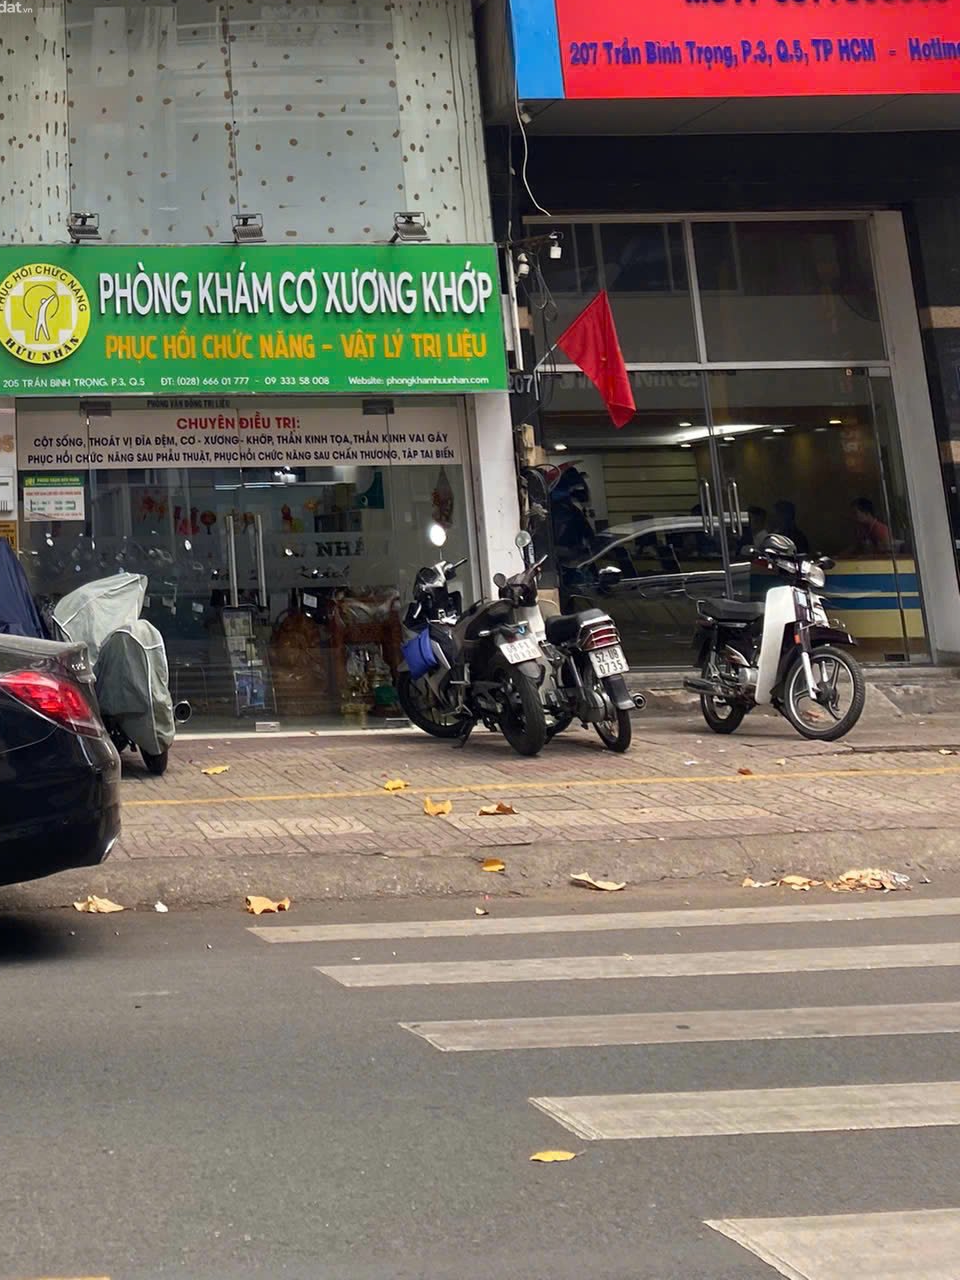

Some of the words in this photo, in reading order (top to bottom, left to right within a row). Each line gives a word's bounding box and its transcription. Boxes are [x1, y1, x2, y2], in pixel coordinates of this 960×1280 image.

[570, 41, 598, 65] 207
[602, 37, 642, 65] Trần
[644, 40, 682, 64] Bình
[685, 40, 739, 69] Trọng,
[740, 39, 773, 67] P.3,
[776, 39, 809, 65] Q.5,
[810, 38, 833, 62] TP
[837, 38, 876, 62] HCM
[99, 262, 192, 315] PHÒNG
[198, 262, 274, 314] KHÁM
[279, 268, 318, 314] CƠ
[322, 268, 418, 314] XƯƠNG
[422, 261, 493, 314] KHỚP
[105, 334, 157, 364] PHỤC
[163, 326, 197, 360] HỒI
[202, 328, 254, 360] CHỨC
[259, 330, 316, 359] NĂNG
[341, 328, 377, 362] VẬT
[383, 327, 404, 358] LÝ
[411, 333, 442, 362] TRỊ
[447, 327, 487, 362] LIỆU
[3, 379, 19, 388] 205
[176, 376, 200, 386] (028)
[202, 377, 219, 386] 666
[221, 377, 231, 386] 01
[233, 377, 249, 385] 777
[264, 377, 276, 385] 09
[280, 377, 296, 385] 333
[299, 377, 310, 385] 58
[312, 376, 330, 385] 008
[348, 376, 384, 385] Website:
[176, 414, 236, 430] CHUYÊN
[240, 410, 272, 430] ĐIỀU
[275, 417, 301, 432] TRỊ:
[33, 435, 53, 450] CỘT
[56, 434, 86, 449] SỐNG,
[89, 435, 120, 447] THOÁT
[123, 436, 133, 449] VỊ
[154, 434, 178, 448] ĐỆM,
[180, 435, 196, 446] CƠ
[204, 435, 239, 445] XƯƠNG
[246, 433, 275, 446] KHỚP,
[276, 430, 302, 445] THẦN
[305, 433, 328, 444] KINH
[382, 433, 406, 443] KINH
[408, 433, 425, 443] VAI
[28, 454, 53, 466] PHỤC
[56, 450, 73, 464] HỒI
[75, 451, 103, 464] CHỨC
[137, 453, 153, 463] SAU
[214, 452, 239, 463] PHỤC
[258, 450, 283, 461] CHỨC
[314, 451, 330, 460] SAU
[421, 449, 433, 459] TAI
[435, 446, 455, 459] BIẾN
[598, 659, 624, 675] 0735
